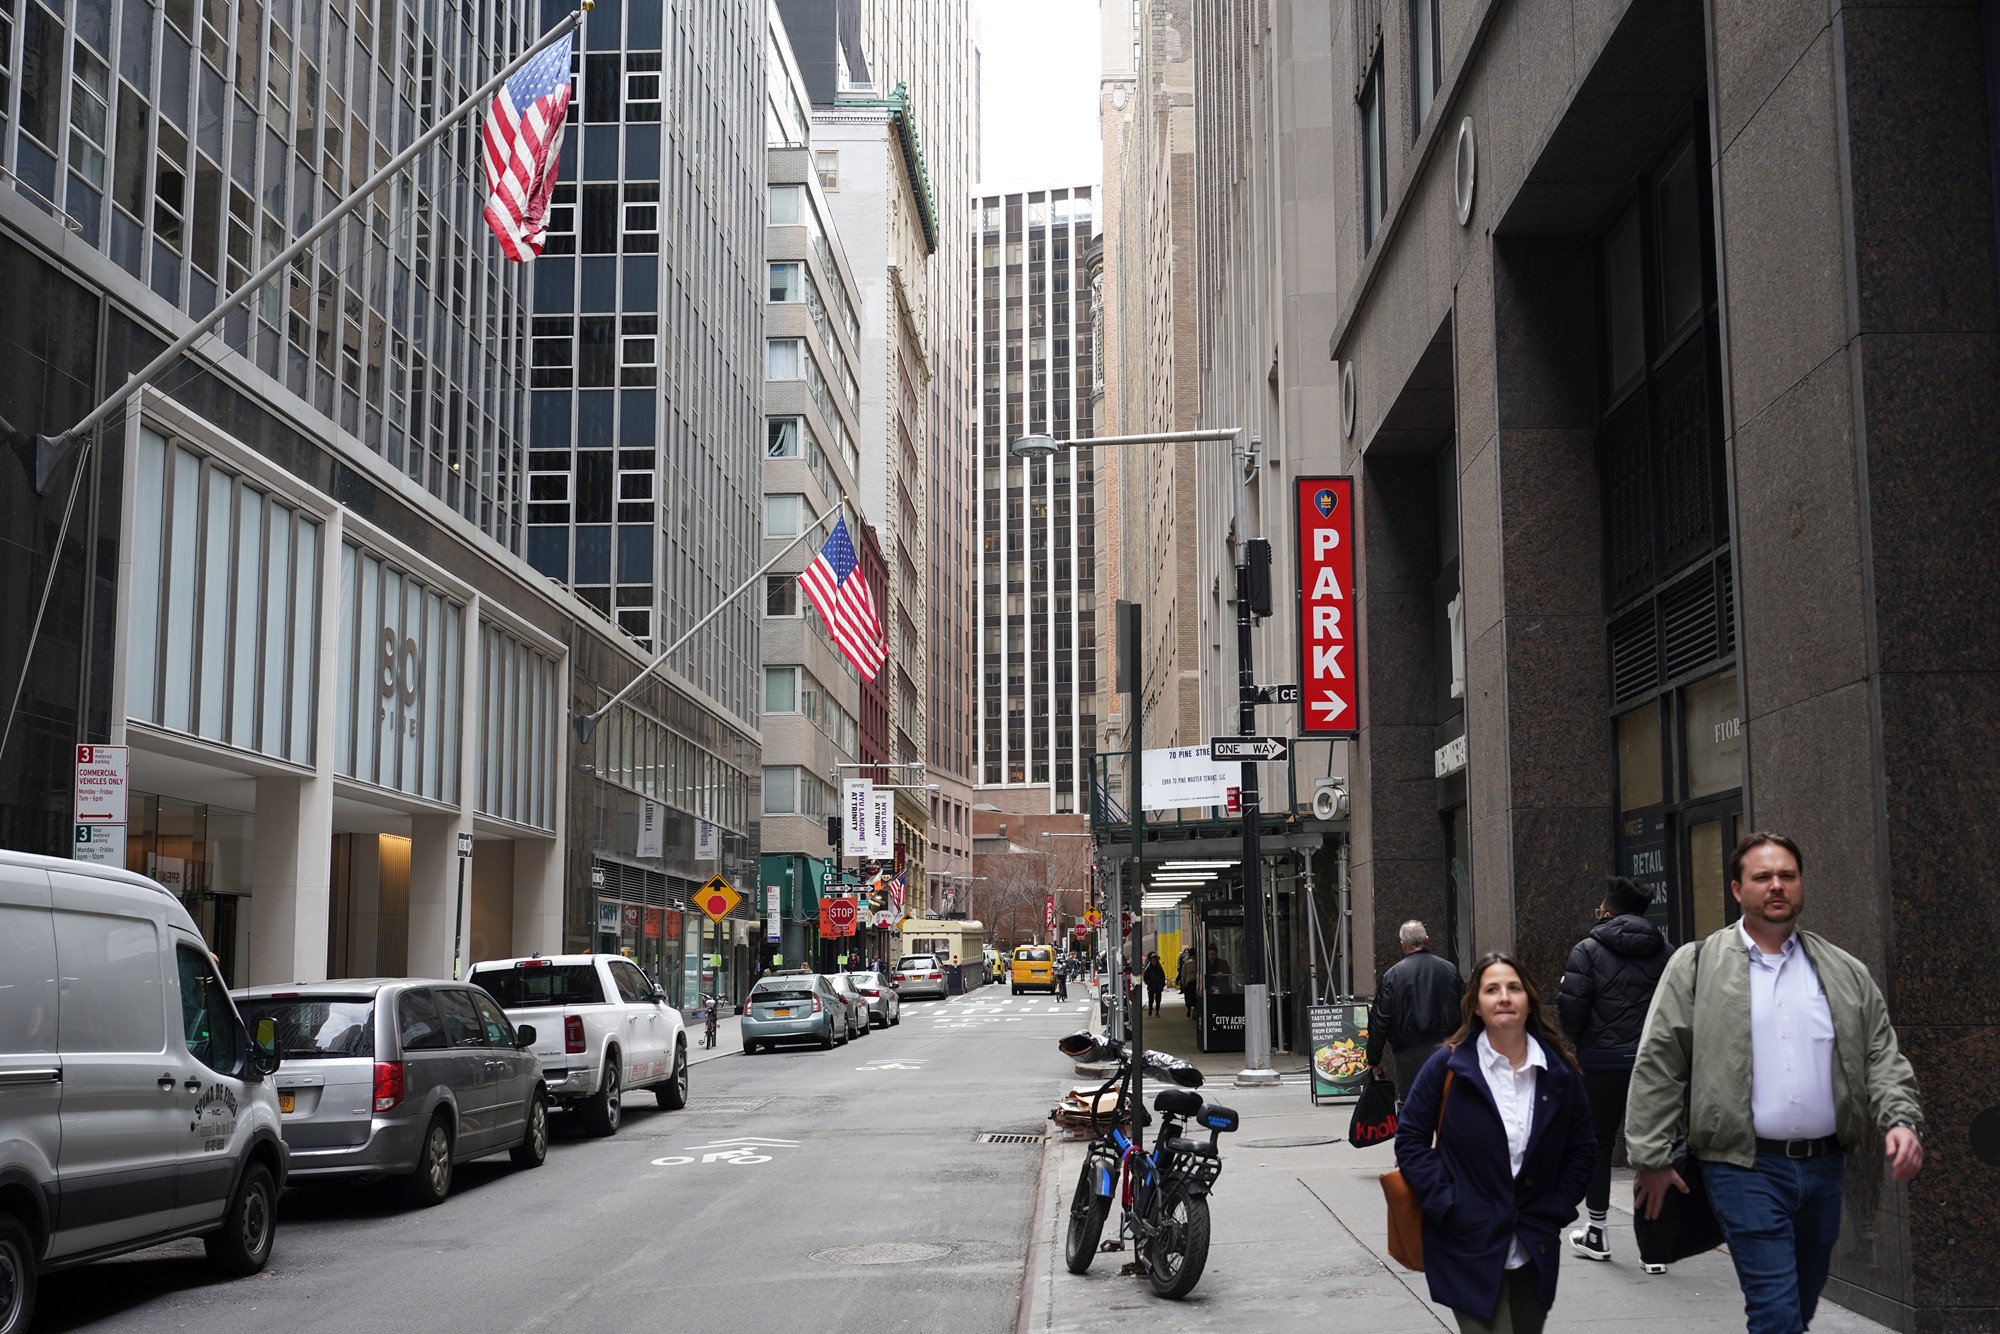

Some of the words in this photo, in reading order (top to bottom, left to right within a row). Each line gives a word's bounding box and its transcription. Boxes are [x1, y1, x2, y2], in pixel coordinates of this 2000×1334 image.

[1311, 528, 1346, 679] PARK
[382, 627, 418, 706] 80
[81, 747, 90, 762] 3
[1179, 750, 1192, 758] PINE
[1196, 748, 1210, 756] STRE
[1218, 744, 1240, 754] ONE
[1253, 744, 1277, 754] WAY
[852, 792, 857, 802] AT
[875, 802, 880, 812] AT
[79, 826, 88, 841] 3
[1633, 850, 1664, 876] RETAIL
[831, 908, 853, 918] STOP
[1216, 1016, 1229, 1025] CITY
[1230, 1016, 1245, 1025] ACRE
[1356, 1115, 1398, 1141] Knoll
